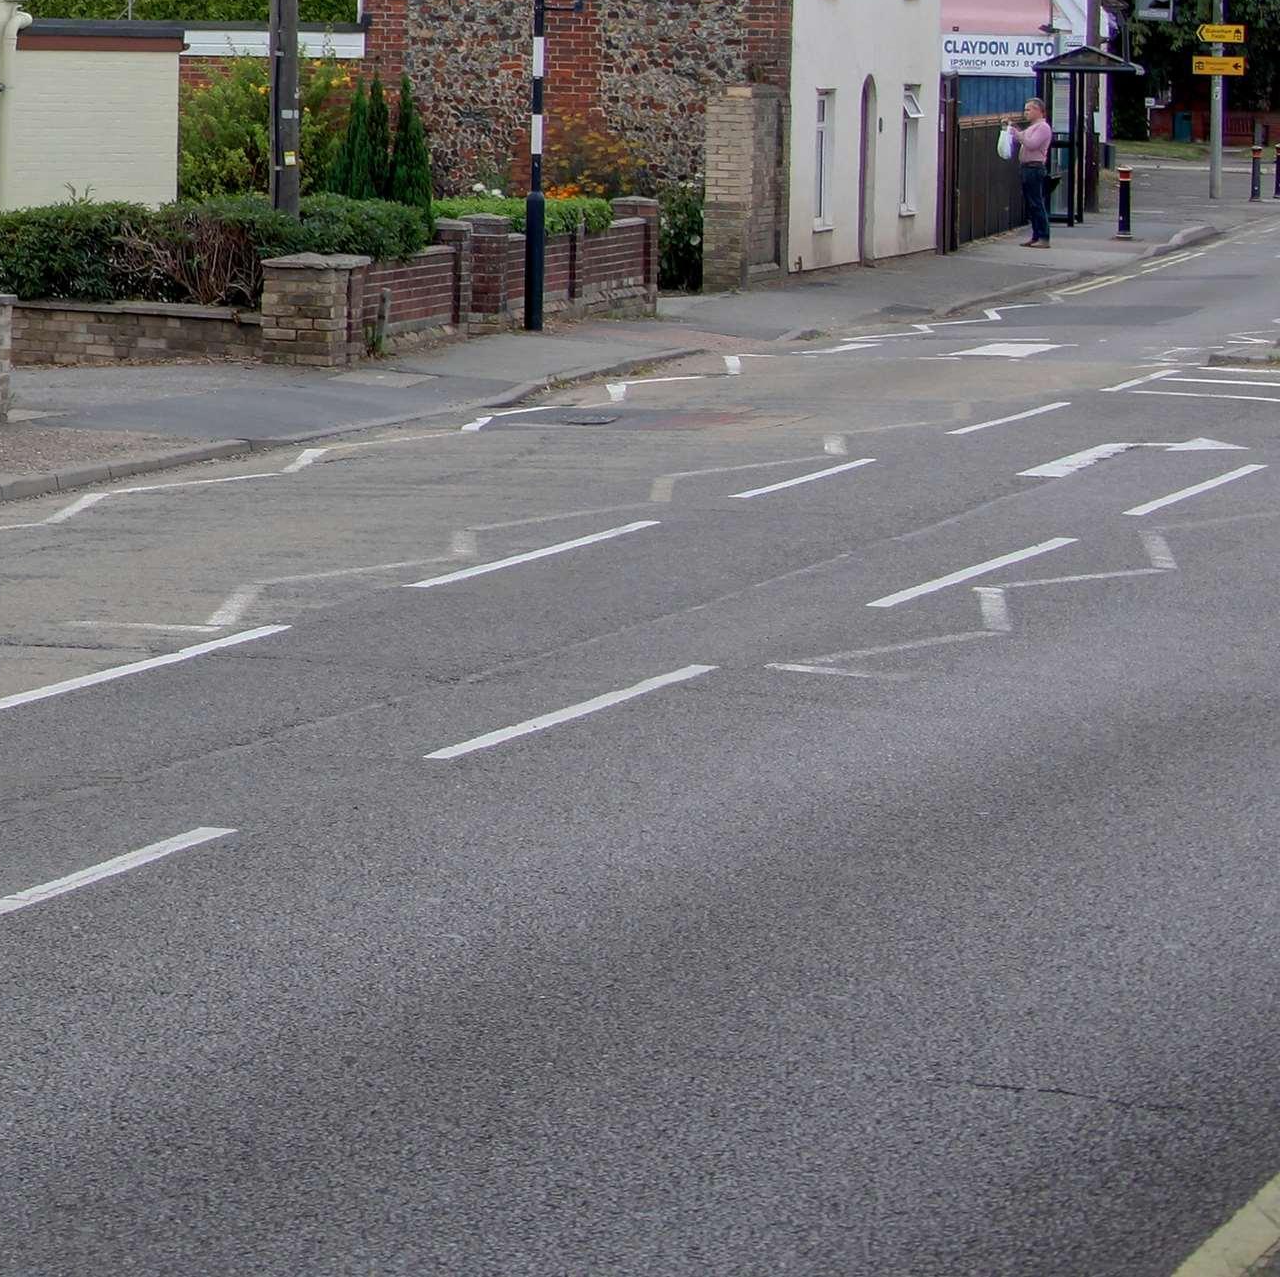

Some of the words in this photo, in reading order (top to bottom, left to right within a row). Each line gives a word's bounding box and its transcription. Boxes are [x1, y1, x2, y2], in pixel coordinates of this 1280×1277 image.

[943, 40, 1009, 56] CLAYDON
[1015, 42, 1055, 57] AUTO
[950, 58, 987, 67] IPSWICH
